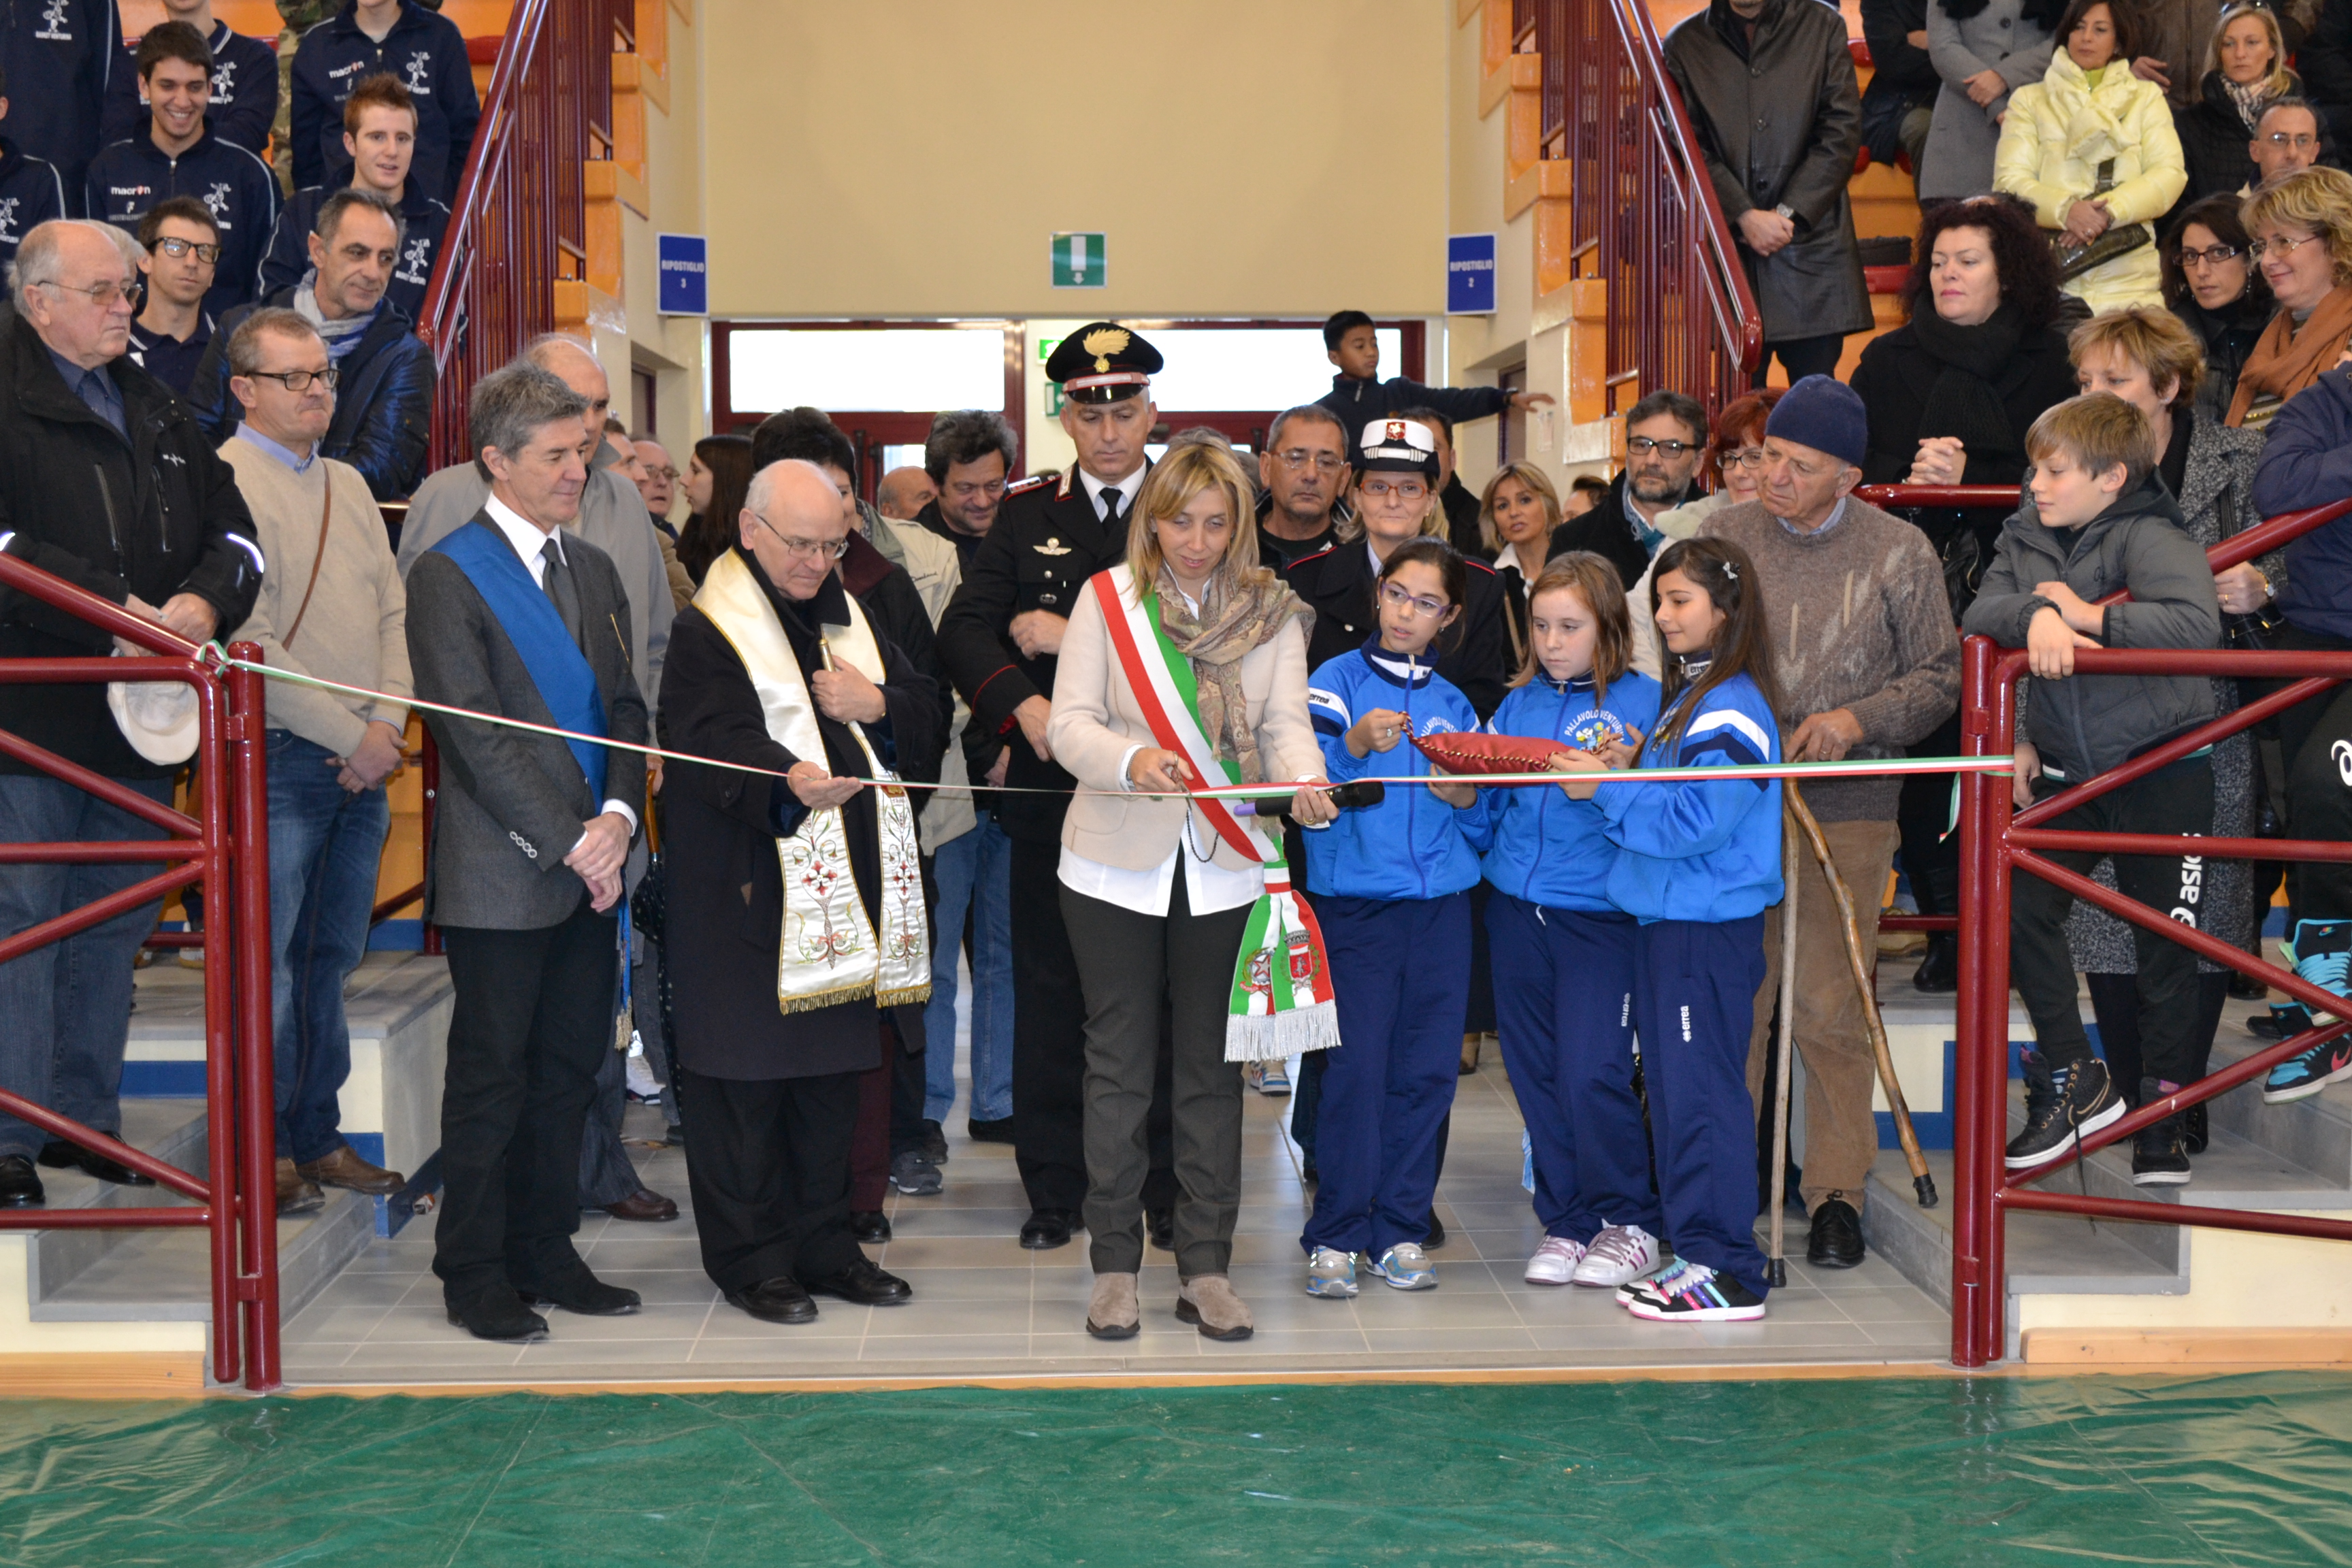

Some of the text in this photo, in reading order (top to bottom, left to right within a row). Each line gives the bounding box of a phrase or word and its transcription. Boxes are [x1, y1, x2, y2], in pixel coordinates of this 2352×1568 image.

[329, 61, 365, 78] macron
[111, 185, 151, 195] macron
[662, 260, 705, 273] RIPOSTIGLIO
[1450, 259, 1493, 272] RIPOSTIGLIO
[681, 278, 687, 289] 3
[1468, 277, 1474, 288] 2
[1564, 709, 1599, 737] PALLAVOLO
[1680, 1005, 1690, 1030] errea
